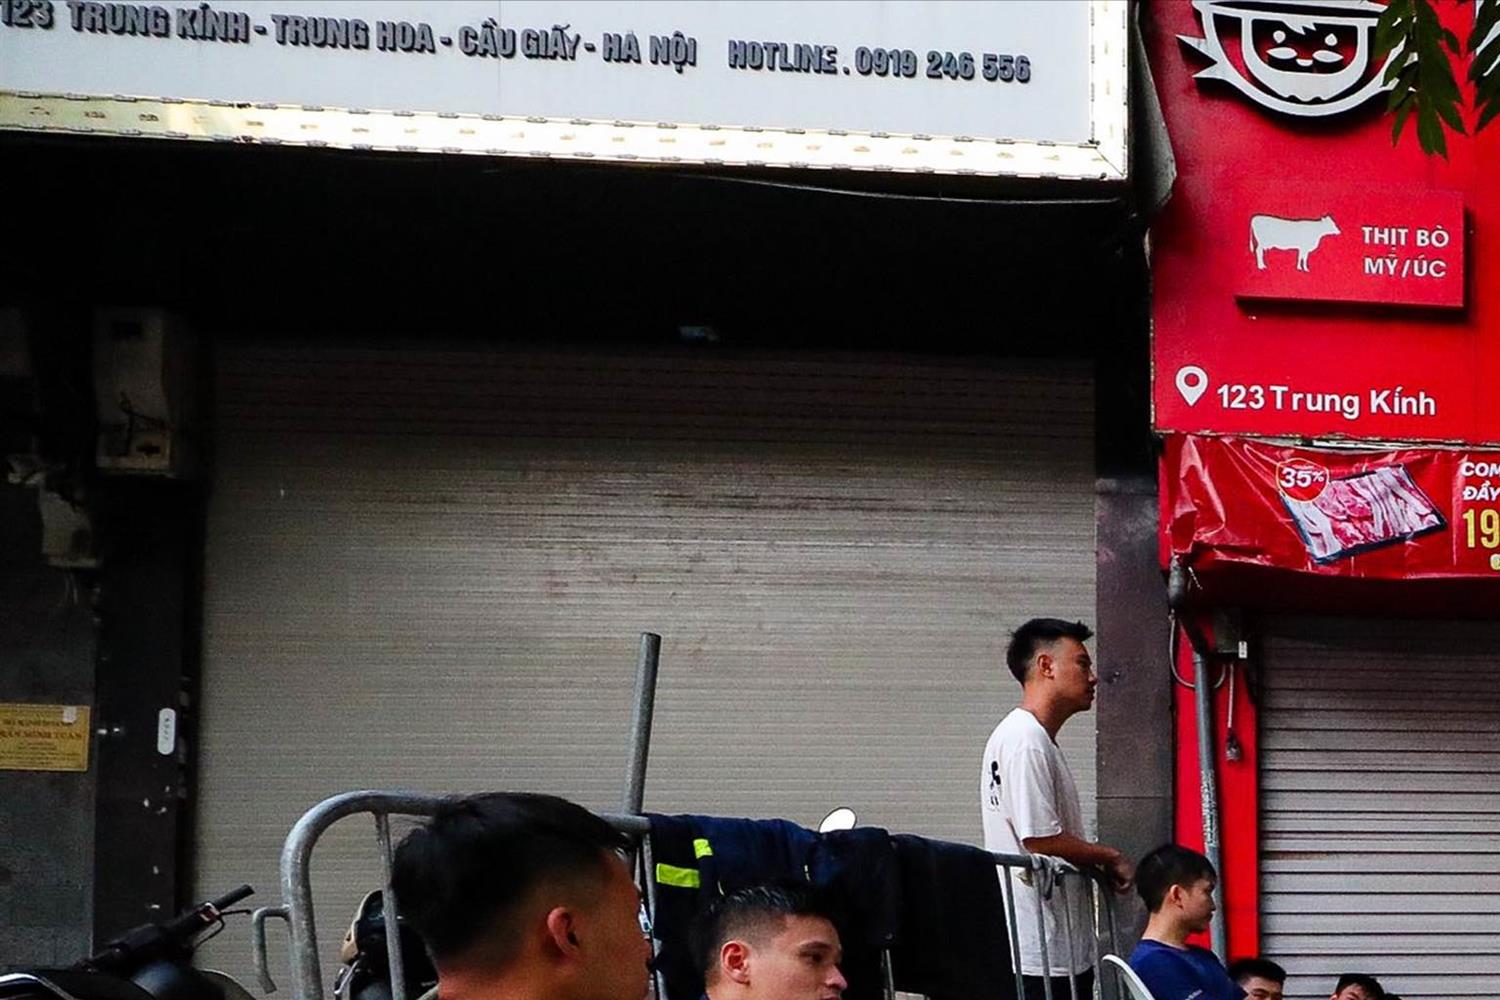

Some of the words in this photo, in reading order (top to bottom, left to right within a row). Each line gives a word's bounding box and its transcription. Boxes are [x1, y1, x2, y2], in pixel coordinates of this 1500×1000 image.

[70, 1, 169, 37] TRUNG
[176, 2, 250, 42] KÍNH
[271, 13, 369, 49] TRUNG
[458, 17, 516, 58] CẦU
[648, 30, 698, 73] NỘI
[855, 45, 918, 78] 0919
[925, 50, 976, 81] 246
[981, 52, 1033, 84] 556
[1361, 226, 1408, 250] THỊT
[1416, 225, 1450, 248] BÒ
[1216, 384, 1265, 409] 123
[1270, 385, 1360, 420] Trung
[1369, 386, 1436, 416] Kính
[1280, 467, 1325, 488] 35%
